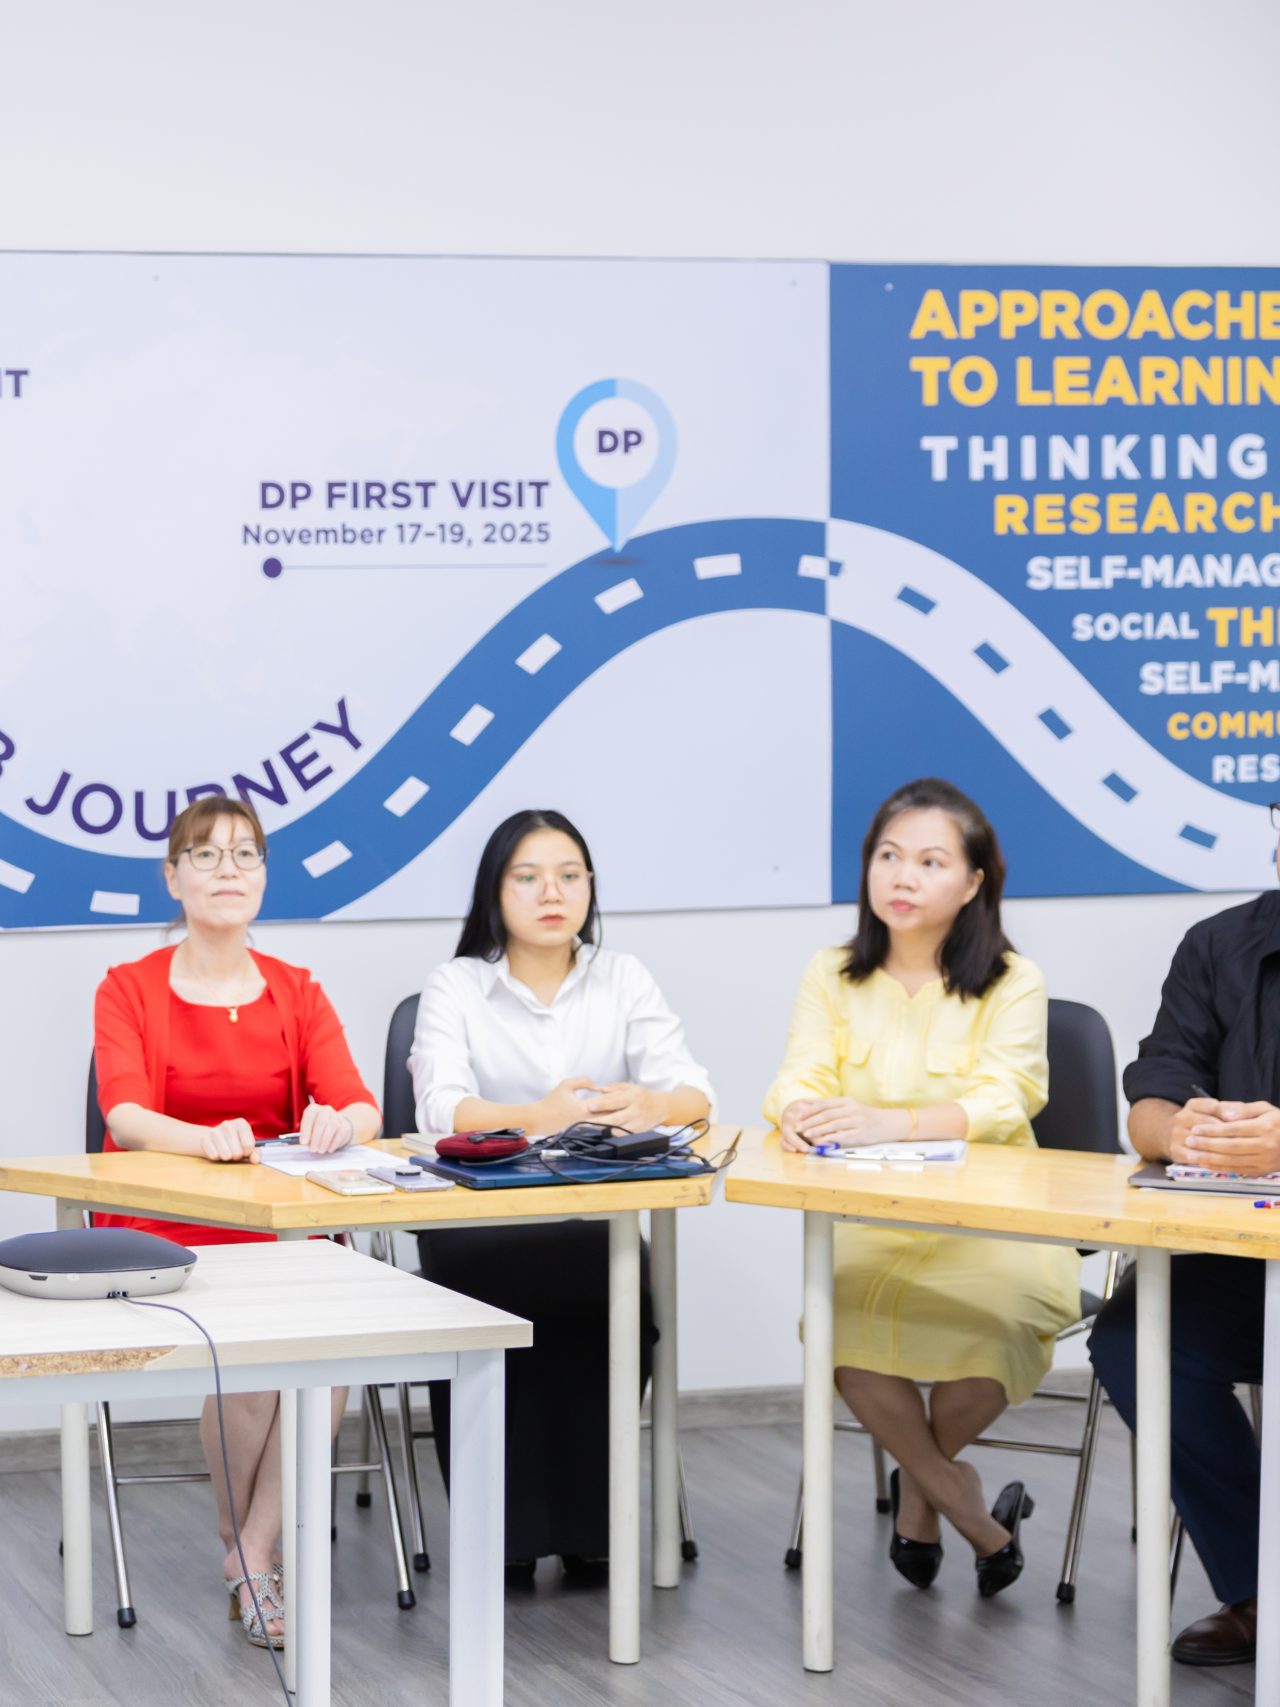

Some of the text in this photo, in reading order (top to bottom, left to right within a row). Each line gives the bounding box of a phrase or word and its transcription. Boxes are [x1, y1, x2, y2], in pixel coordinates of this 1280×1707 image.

[909, 355, 999, 407] TO
[597, 430, 643, 454] DP
[920, 432, 1268, 482] THINKING
[260, 480, 550, 510] DP FIRST VISIT
[242, 522, 387, 546] November
[483, 522, 551, 544] 2025
[1072, 606, 1280, 648] SOCIAL TH
[1167, 710, 1280, 741] COMM
[1212, 753, 1280, 784] RES
